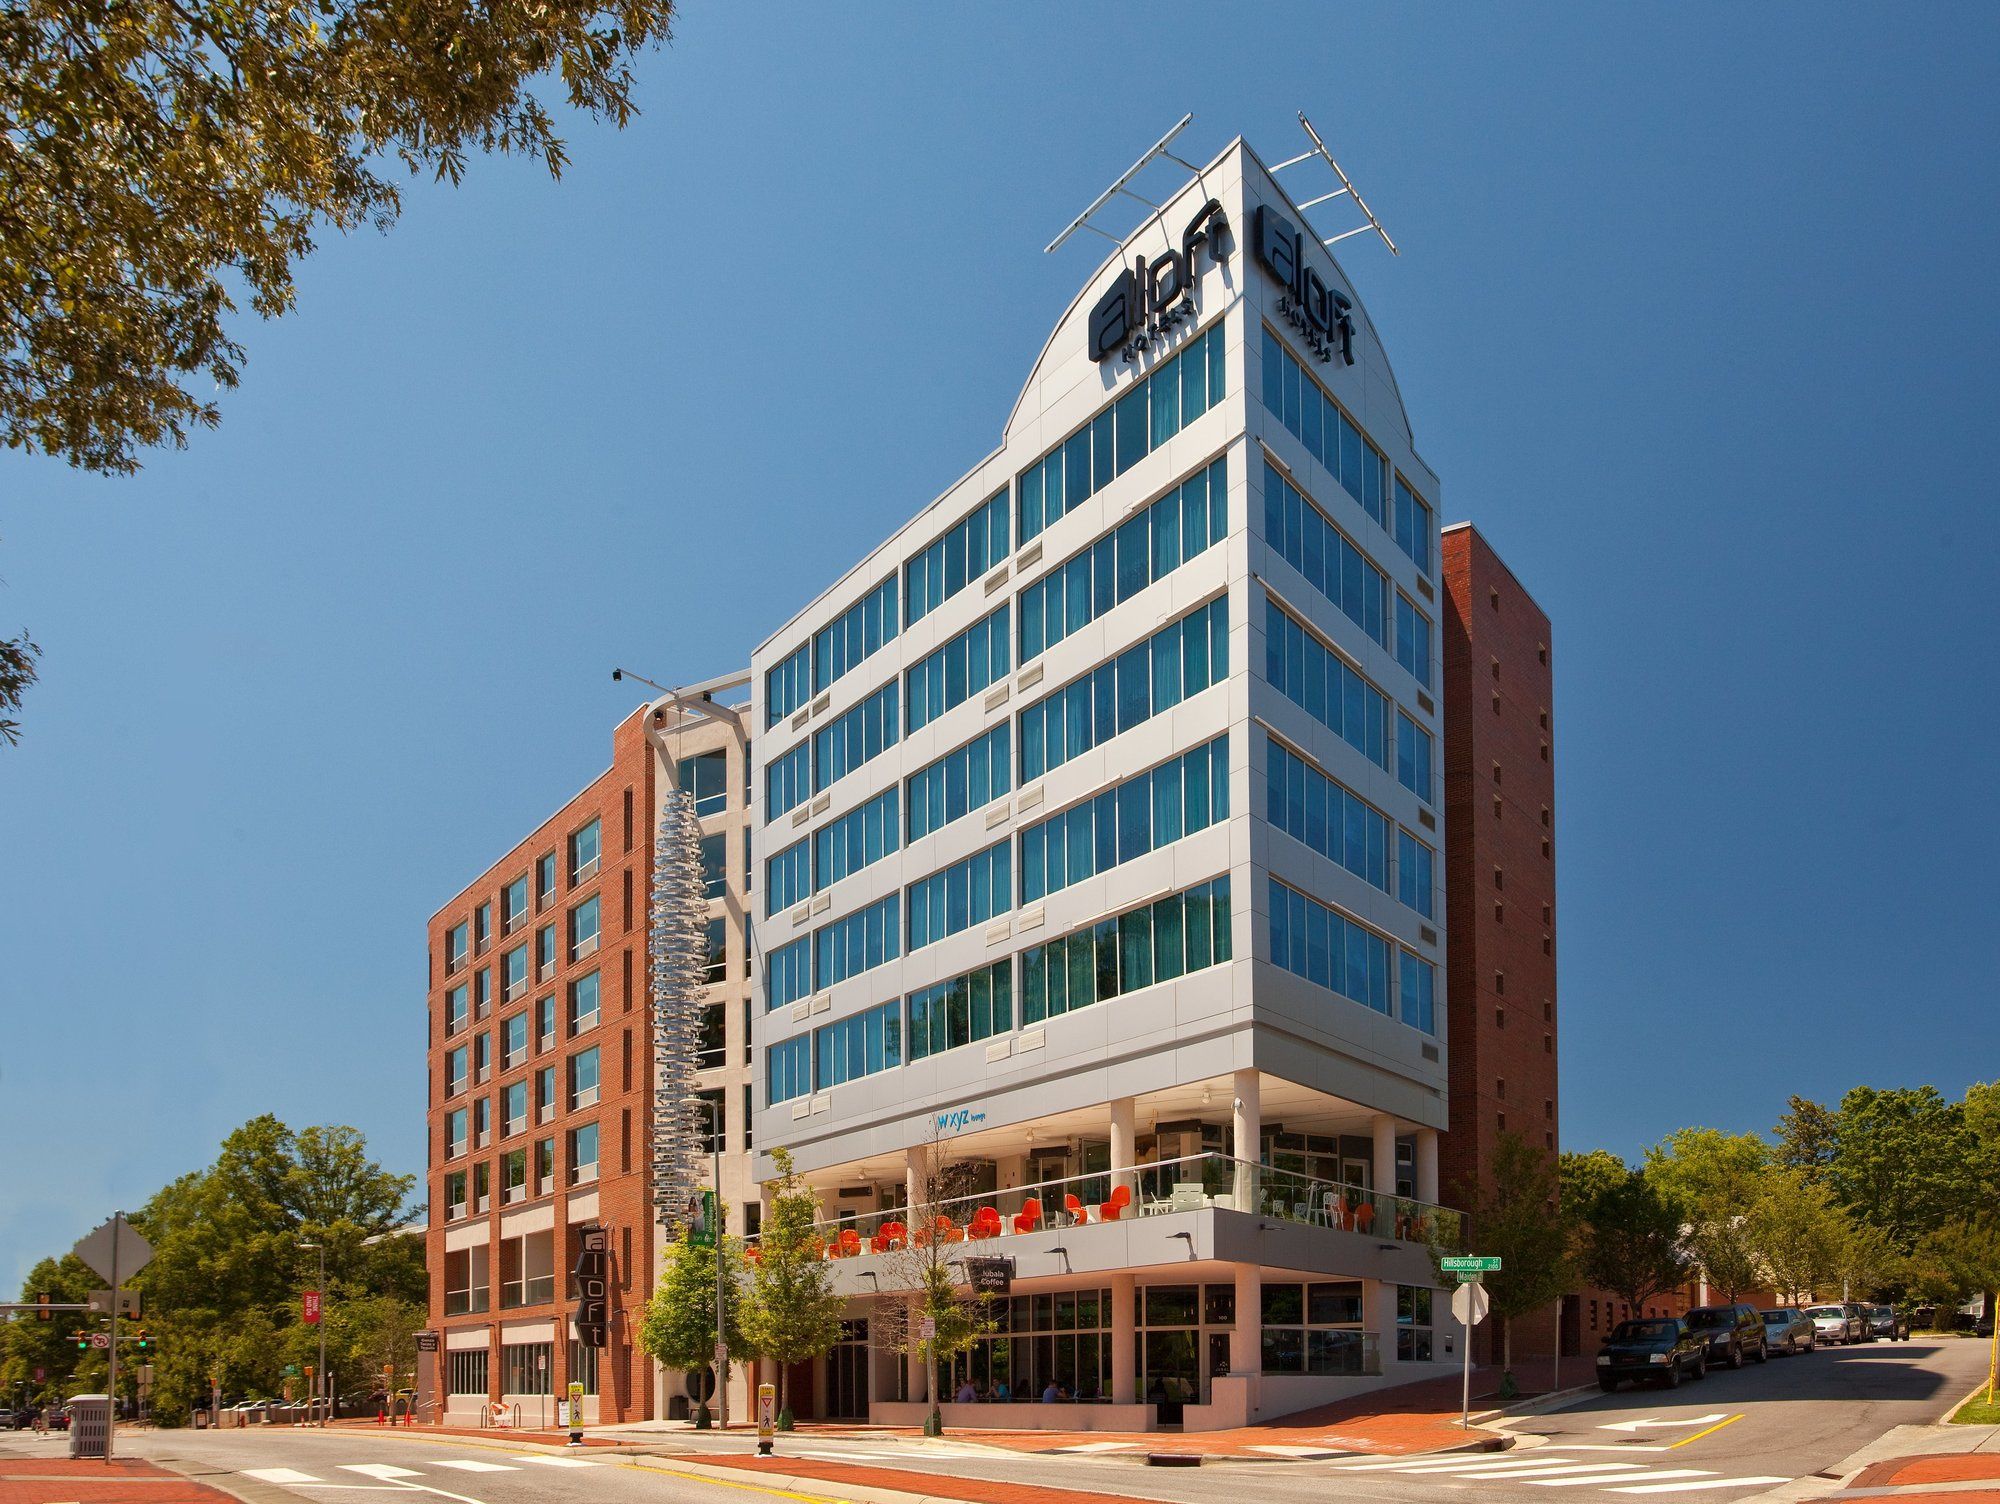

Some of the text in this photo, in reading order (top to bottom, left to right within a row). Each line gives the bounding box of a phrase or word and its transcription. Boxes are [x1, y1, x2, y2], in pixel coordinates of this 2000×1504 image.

[1088, 198, 1229, 362] aloft
[1257, 204, 1355, 366] aloft
[586, 1231, 605, 1345] aloft
[981, 1278, 1004, 1286] Coffee
[1443, 1258, 1483, 1269] Hillsborough
[306, 1308, 312, 1316] DO
